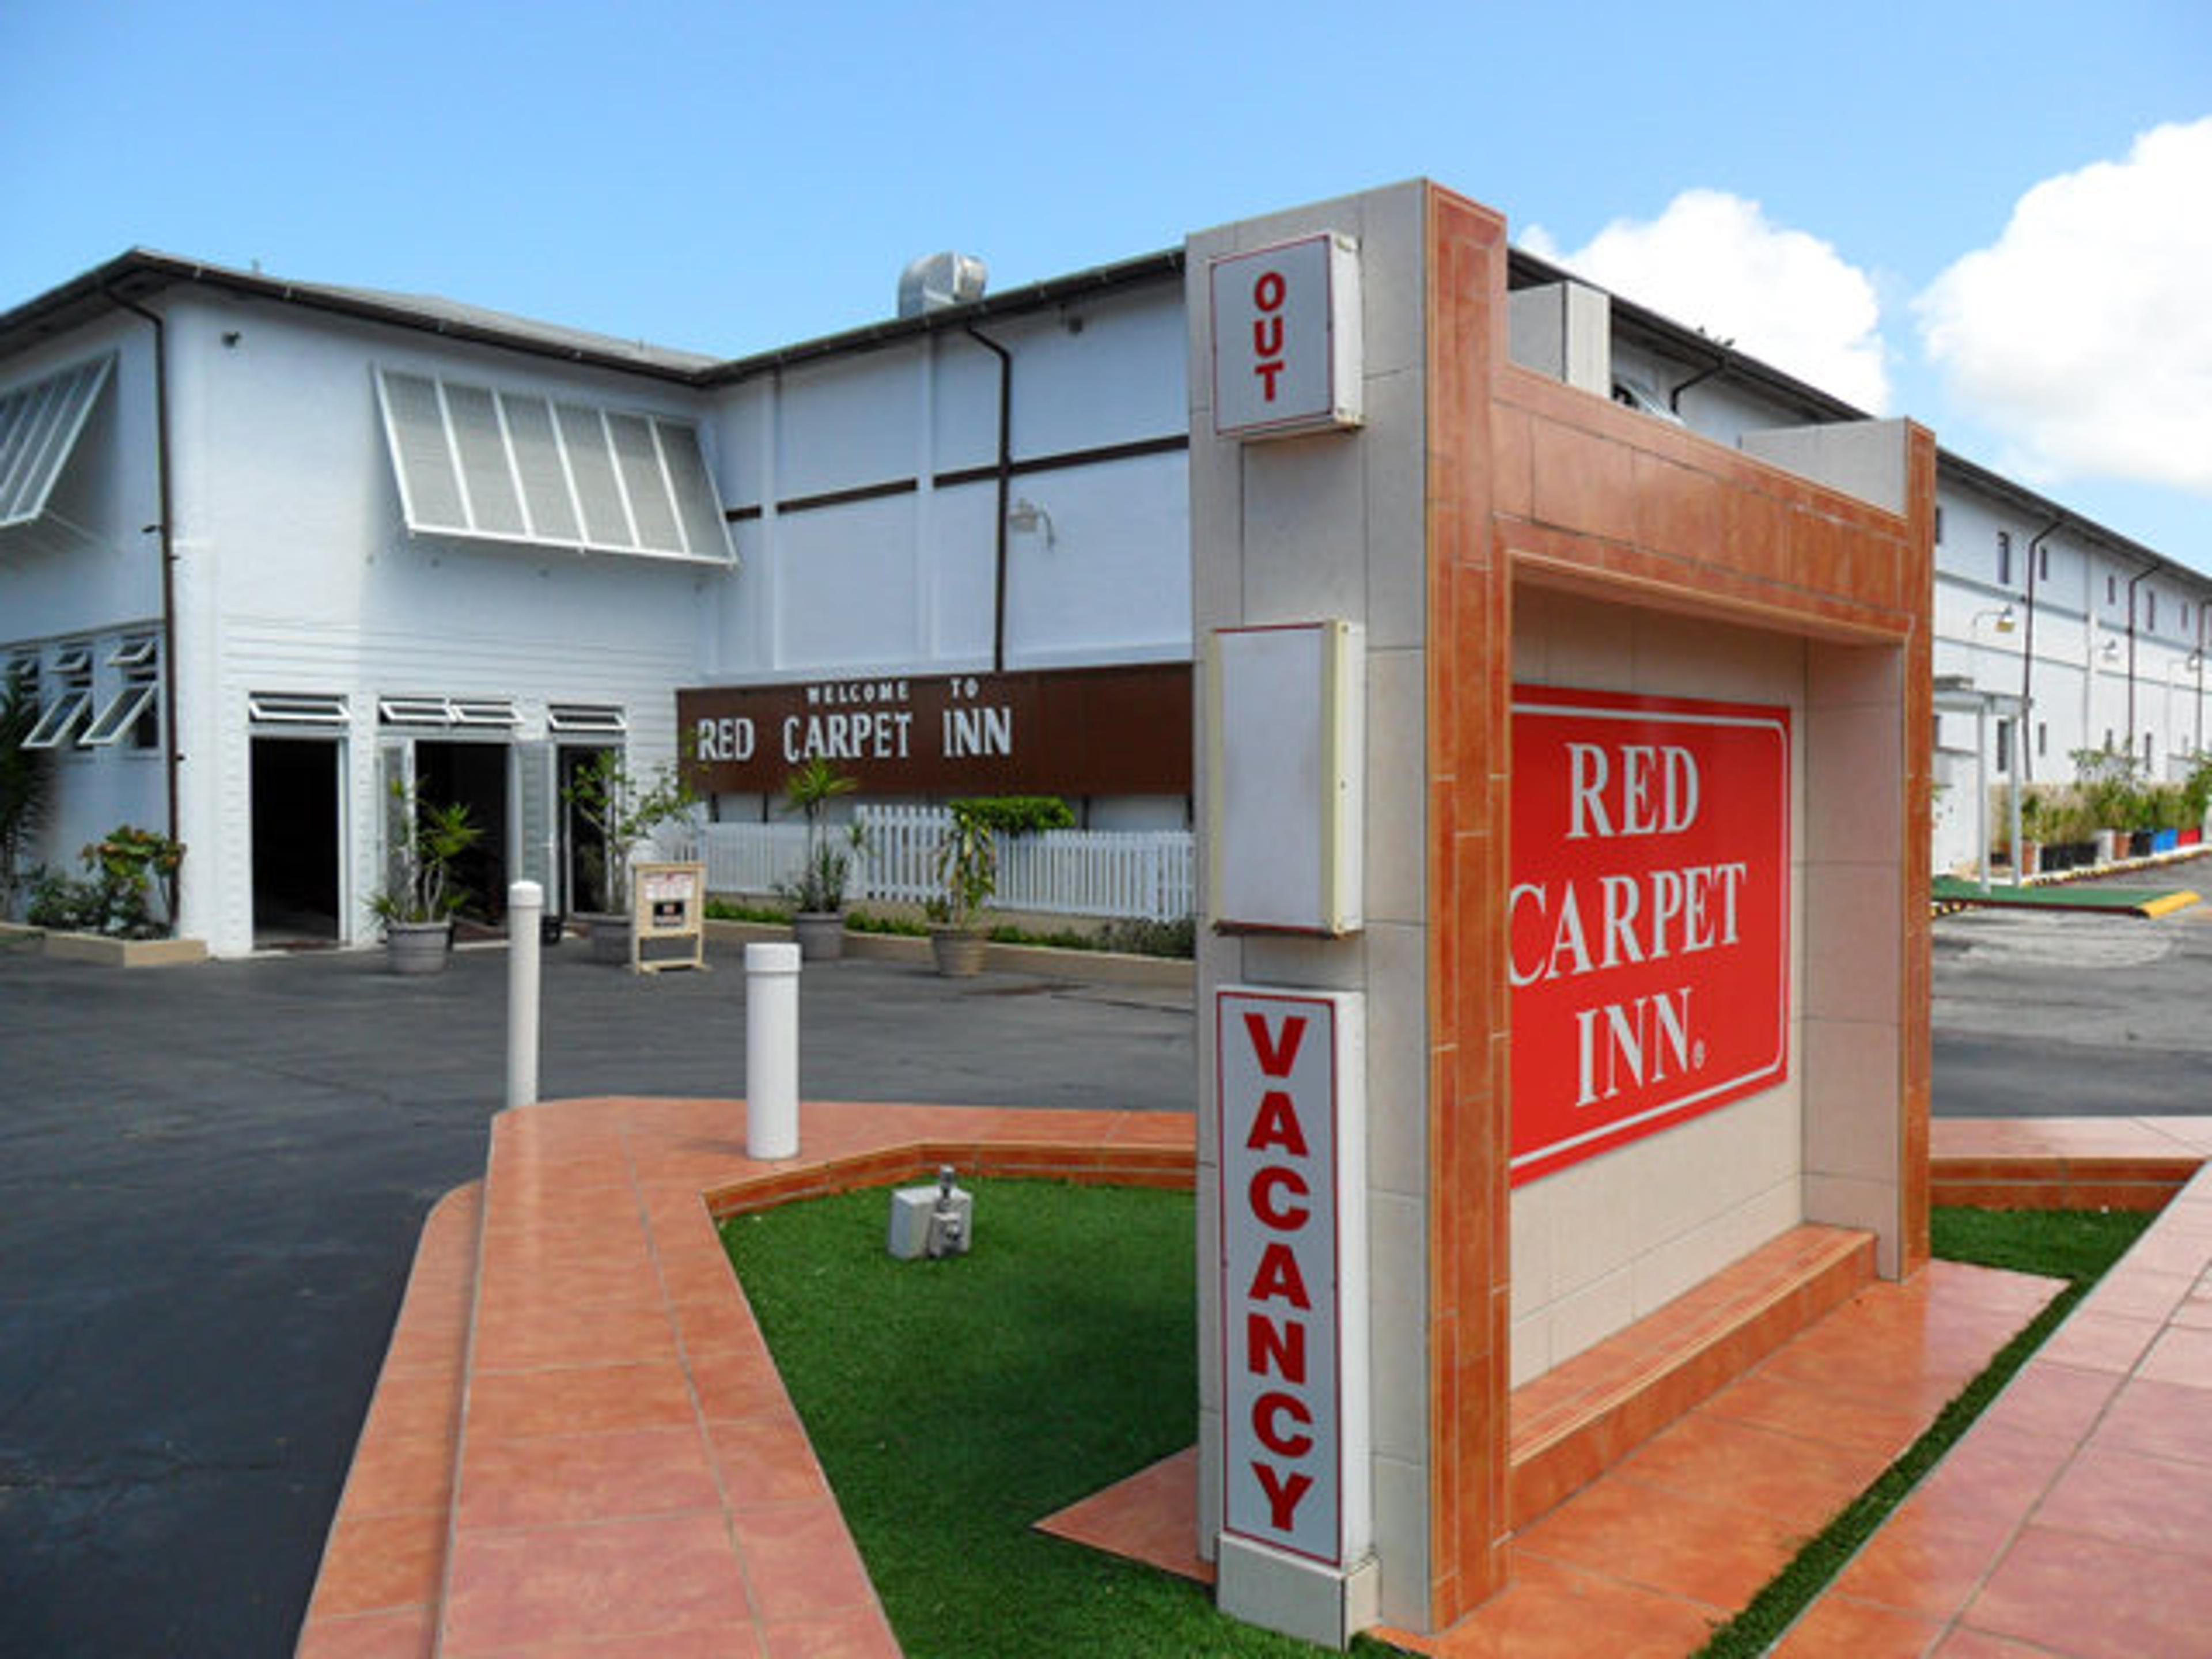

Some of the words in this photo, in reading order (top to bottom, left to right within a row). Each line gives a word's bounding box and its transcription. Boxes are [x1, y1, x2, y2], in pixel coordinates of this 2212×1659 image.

[1253, 270, 1286, 402] OUT
[698, 718, 755, 760] RED
[783, 712, 912, 763] CARPET
[943, 708, 1012, 757] INN
[806, 680, 909, 704] WELCOME
[952, 677, 979, 698] TO
[1566, 743, 1699, 838] RED
[1510, 863, 1747, 986] CARPET
[1244, 1012, 1315, 1532] VACANCY
